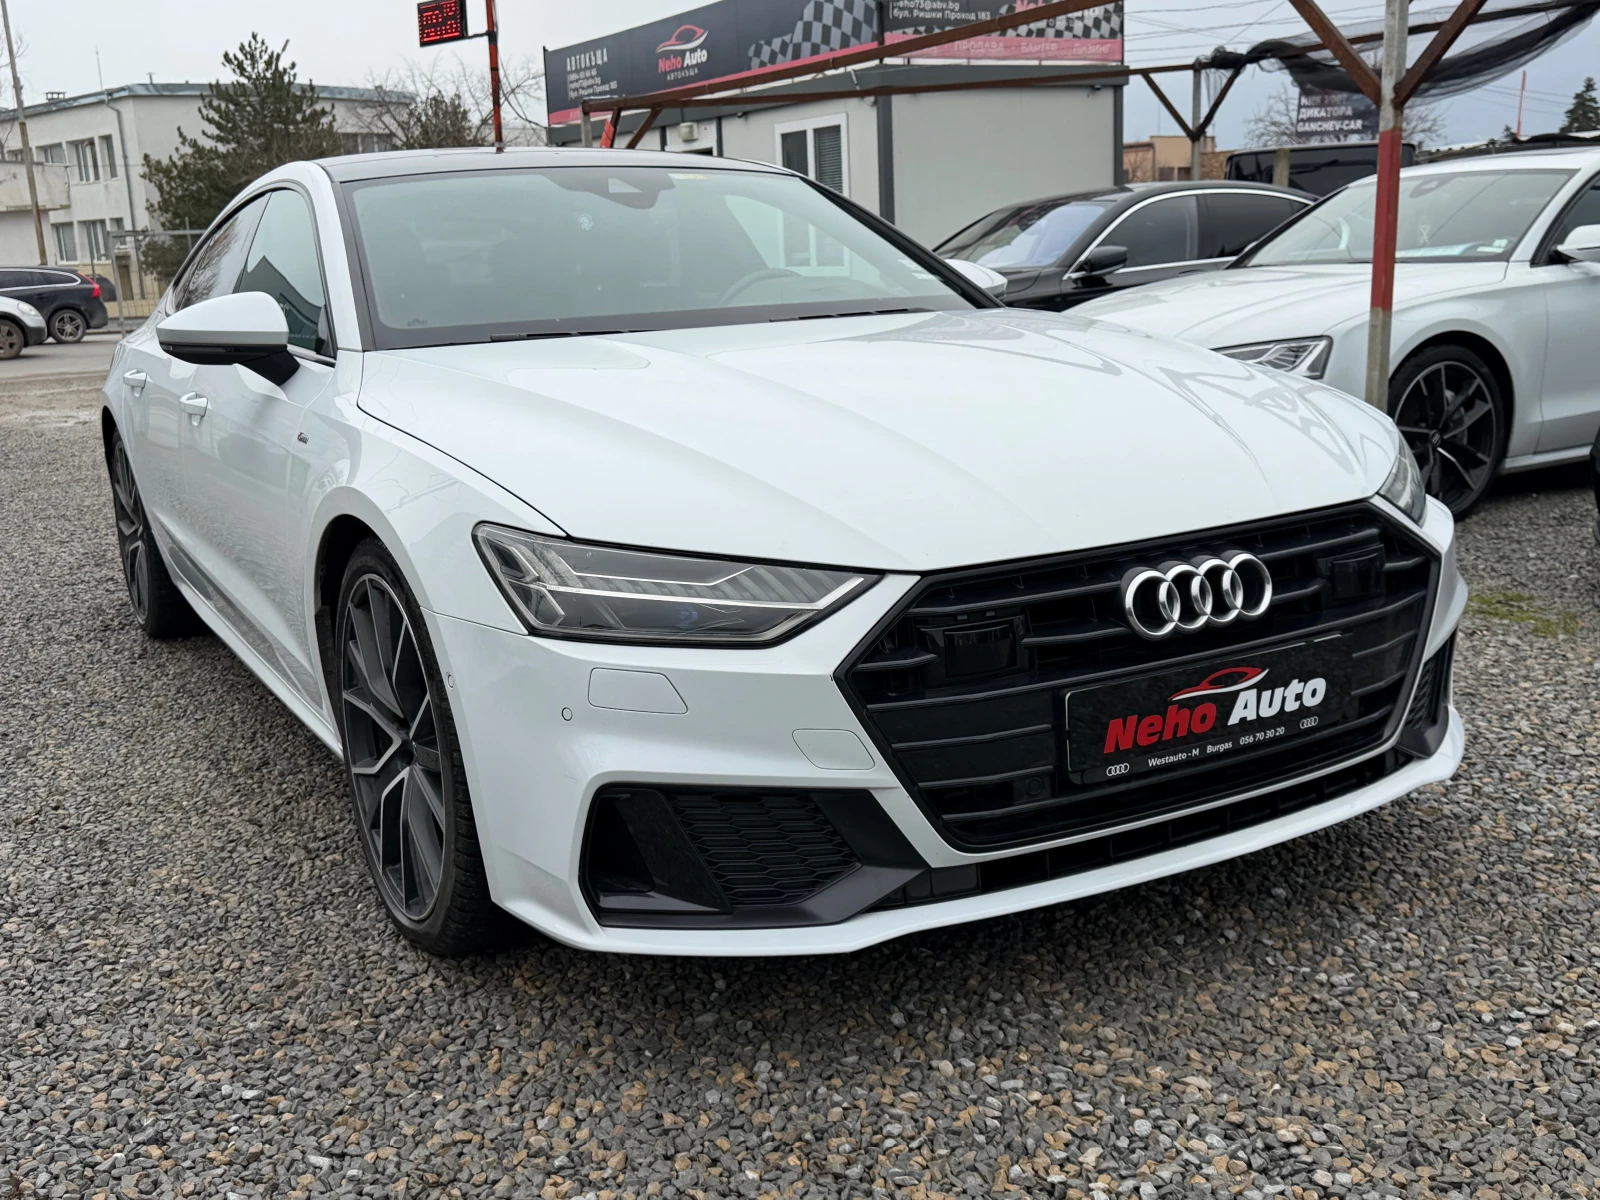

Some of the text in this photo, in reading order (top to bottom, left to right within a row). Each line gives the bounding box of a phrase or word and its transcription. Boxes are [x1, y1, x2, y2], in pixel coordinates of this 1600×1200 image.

[893, 8, 991, 20] бул. Ришки Проход 183
[567, 48, 608, 72] АВТОКЪЩА
[658, 48, 708, 73] Neho Auto
[1103, 677, 1327, 754] Neho Auto
[1148, 752, 1187, 767] Westauto
[1206, 741, 1233, 754] Burgas
[1239, 736, 1254, 746] 056
[1254, 733, 1265, 742] 70
[1265, 730, 1275, 738] 30
[1275, 726, 1285, 735] 20
